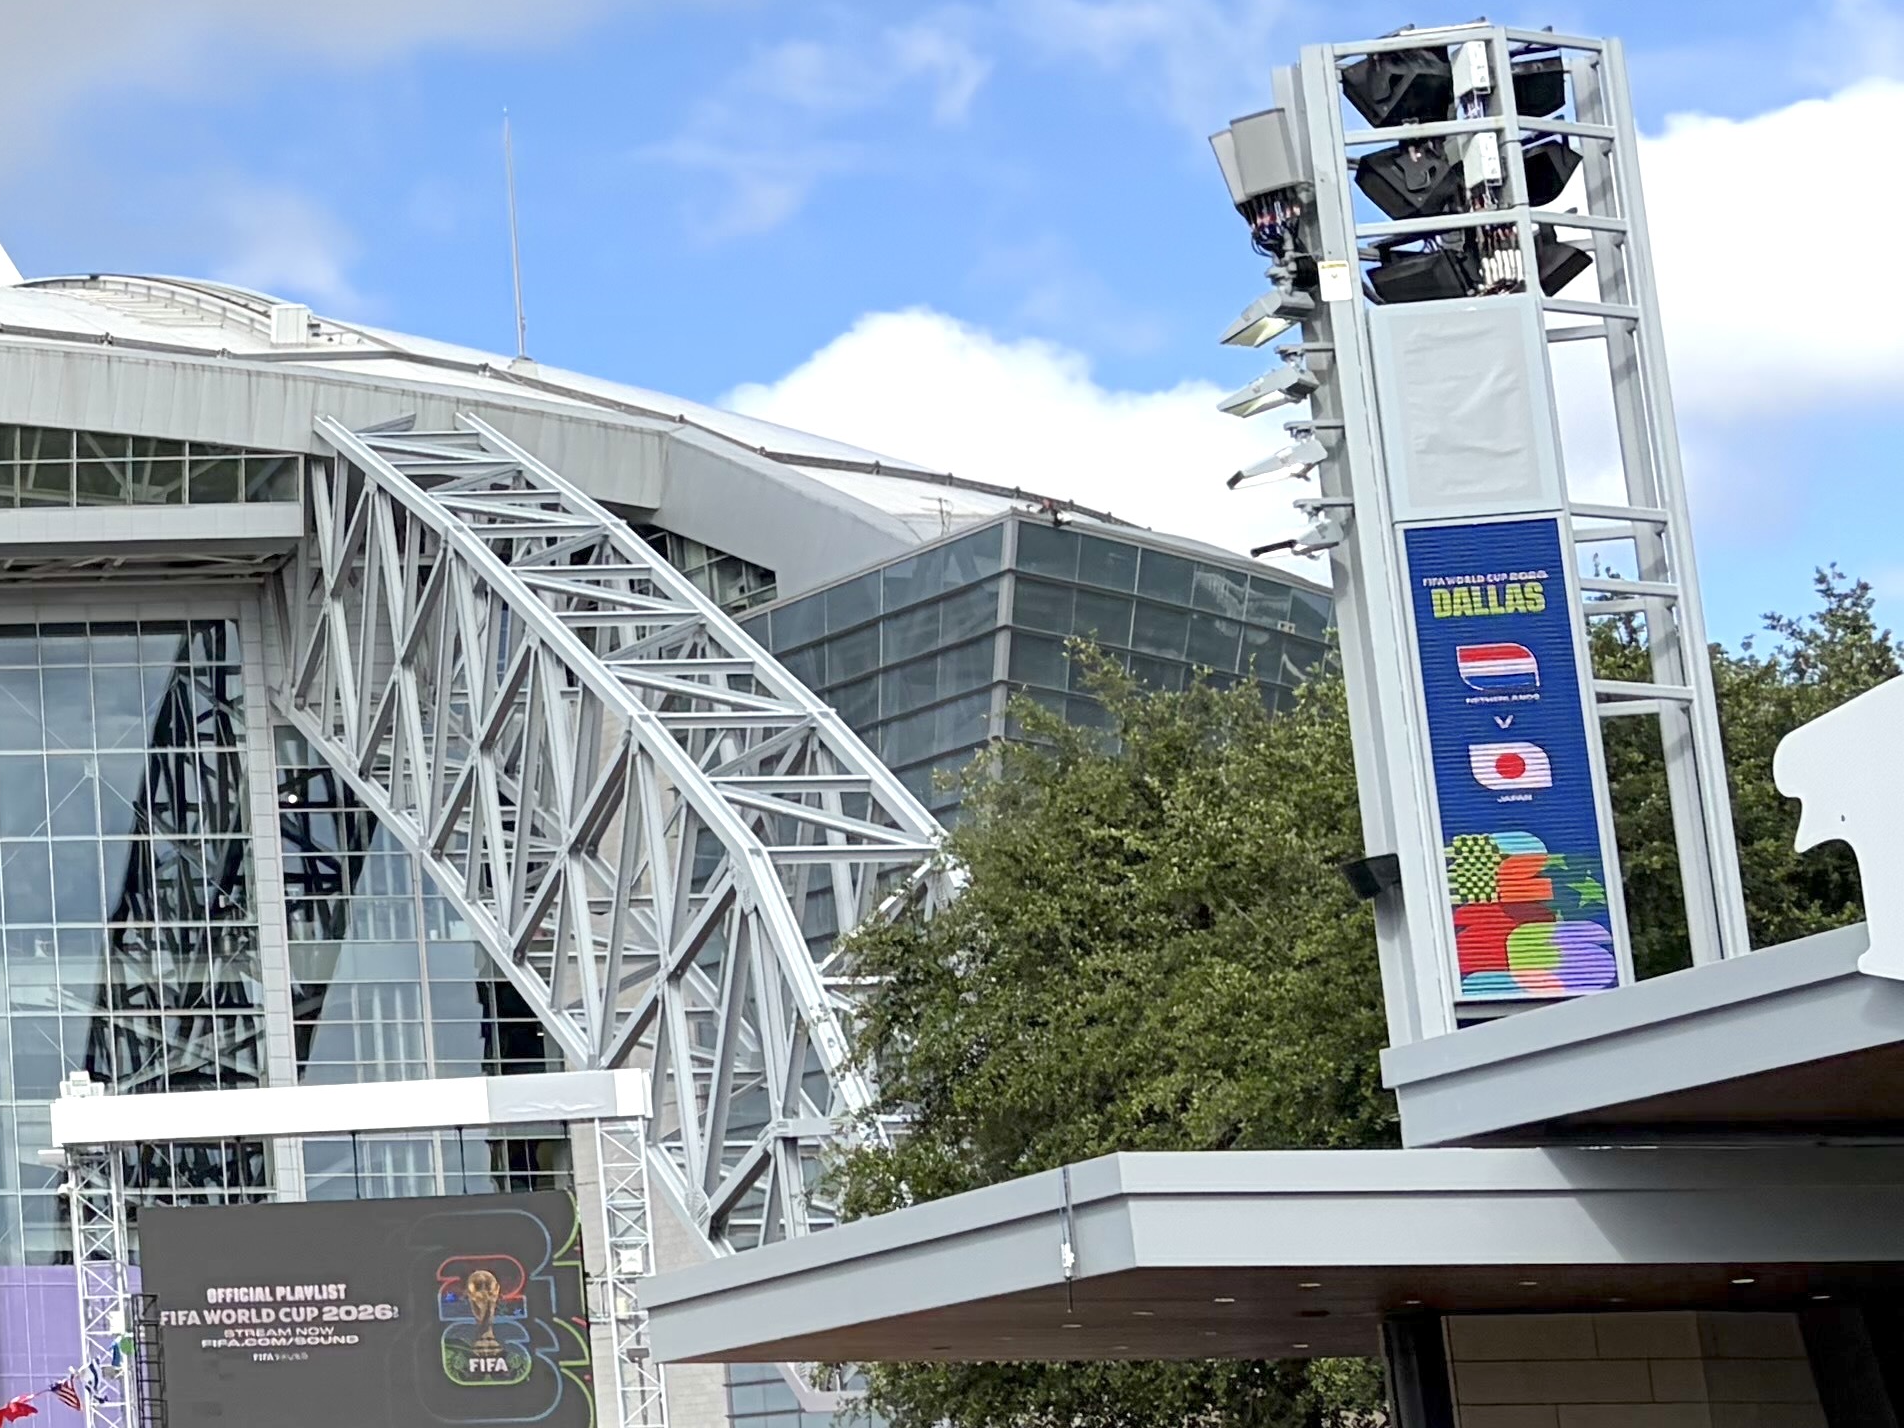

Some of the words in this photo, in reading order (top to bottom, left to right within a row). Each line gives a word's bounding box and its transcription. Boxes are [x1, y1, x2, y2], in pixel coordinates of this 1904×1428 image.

[1431, 582, 1546, 619] DALLAS
[206, 1286, 274, 1304] OFFICIAL
[276, 1284, 347, 1301] PLAYLIST
[159, 1310, 201, 1326] FIFA
[203, 1308, 276, 1324] WORLD
[279, 1306, 319, 1322] CUP
[322, 1304, 392, 1321] 2026
[224, 1328, 292, 1338] STREAM
[295, 1326, 335, 1336] NOW
[201, 1335, 360, 1348] FIFA.COM/SOUND
[468, 1358, 509, 1373] FIFA
